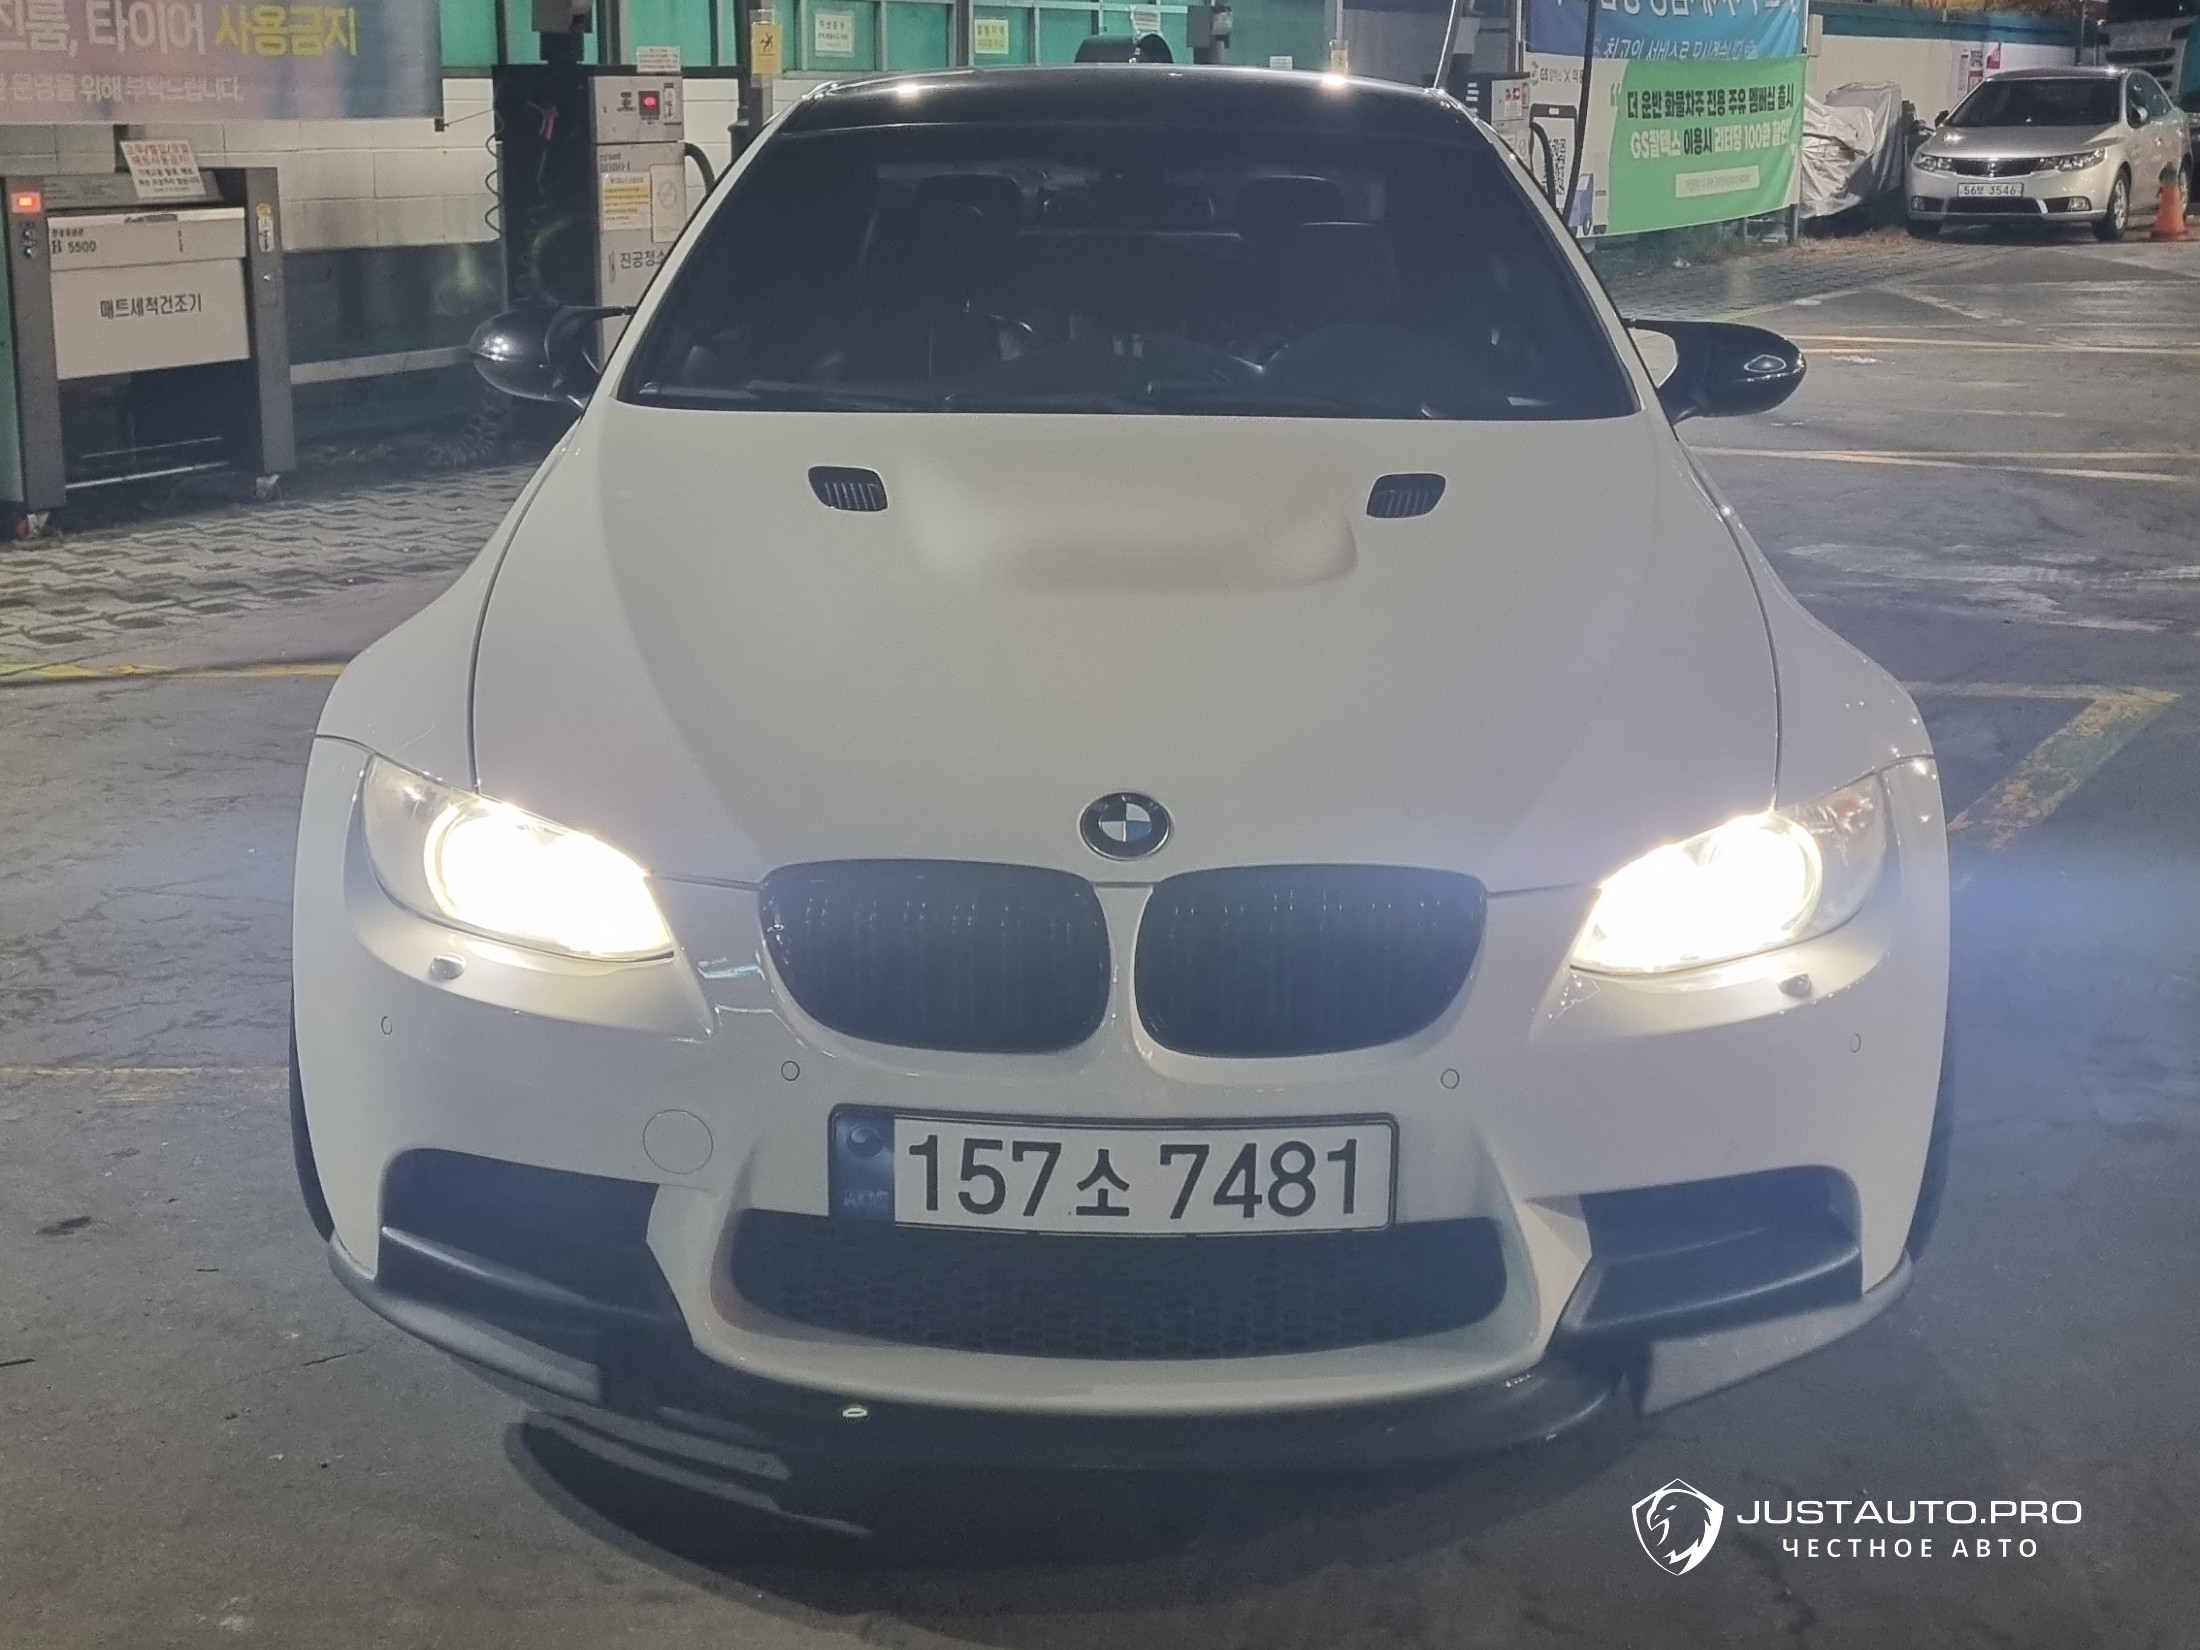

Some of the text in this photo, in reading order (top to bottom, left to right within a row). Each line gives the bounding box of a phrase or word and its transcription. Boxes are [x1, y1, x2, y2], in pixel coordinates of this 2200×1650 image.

[86, 0, 207, 56] 타이어
[213, 4, 358, 57] 사용금지
[80, 73, 122, 102] 위해
[1641, 90, 1663, 119] 운반
[1664, 89, 1705, 118] 화물차주
[1706, 88, 1726, 117] 전용
[1728, 88, 1747, 116] 주유
[1748, 85, 1776, 114] 멤버십
[1777, 82, 1794, 111] 출시
[1683, 127, 1713, 156] 이용시
[1988, 184, 2017, 196] 3546
[67, 240, 97, 254] 5500
[99, 293, 203, 320] 매트세척건조기
[908, 1133, 1360, 1220] 157소 7481
